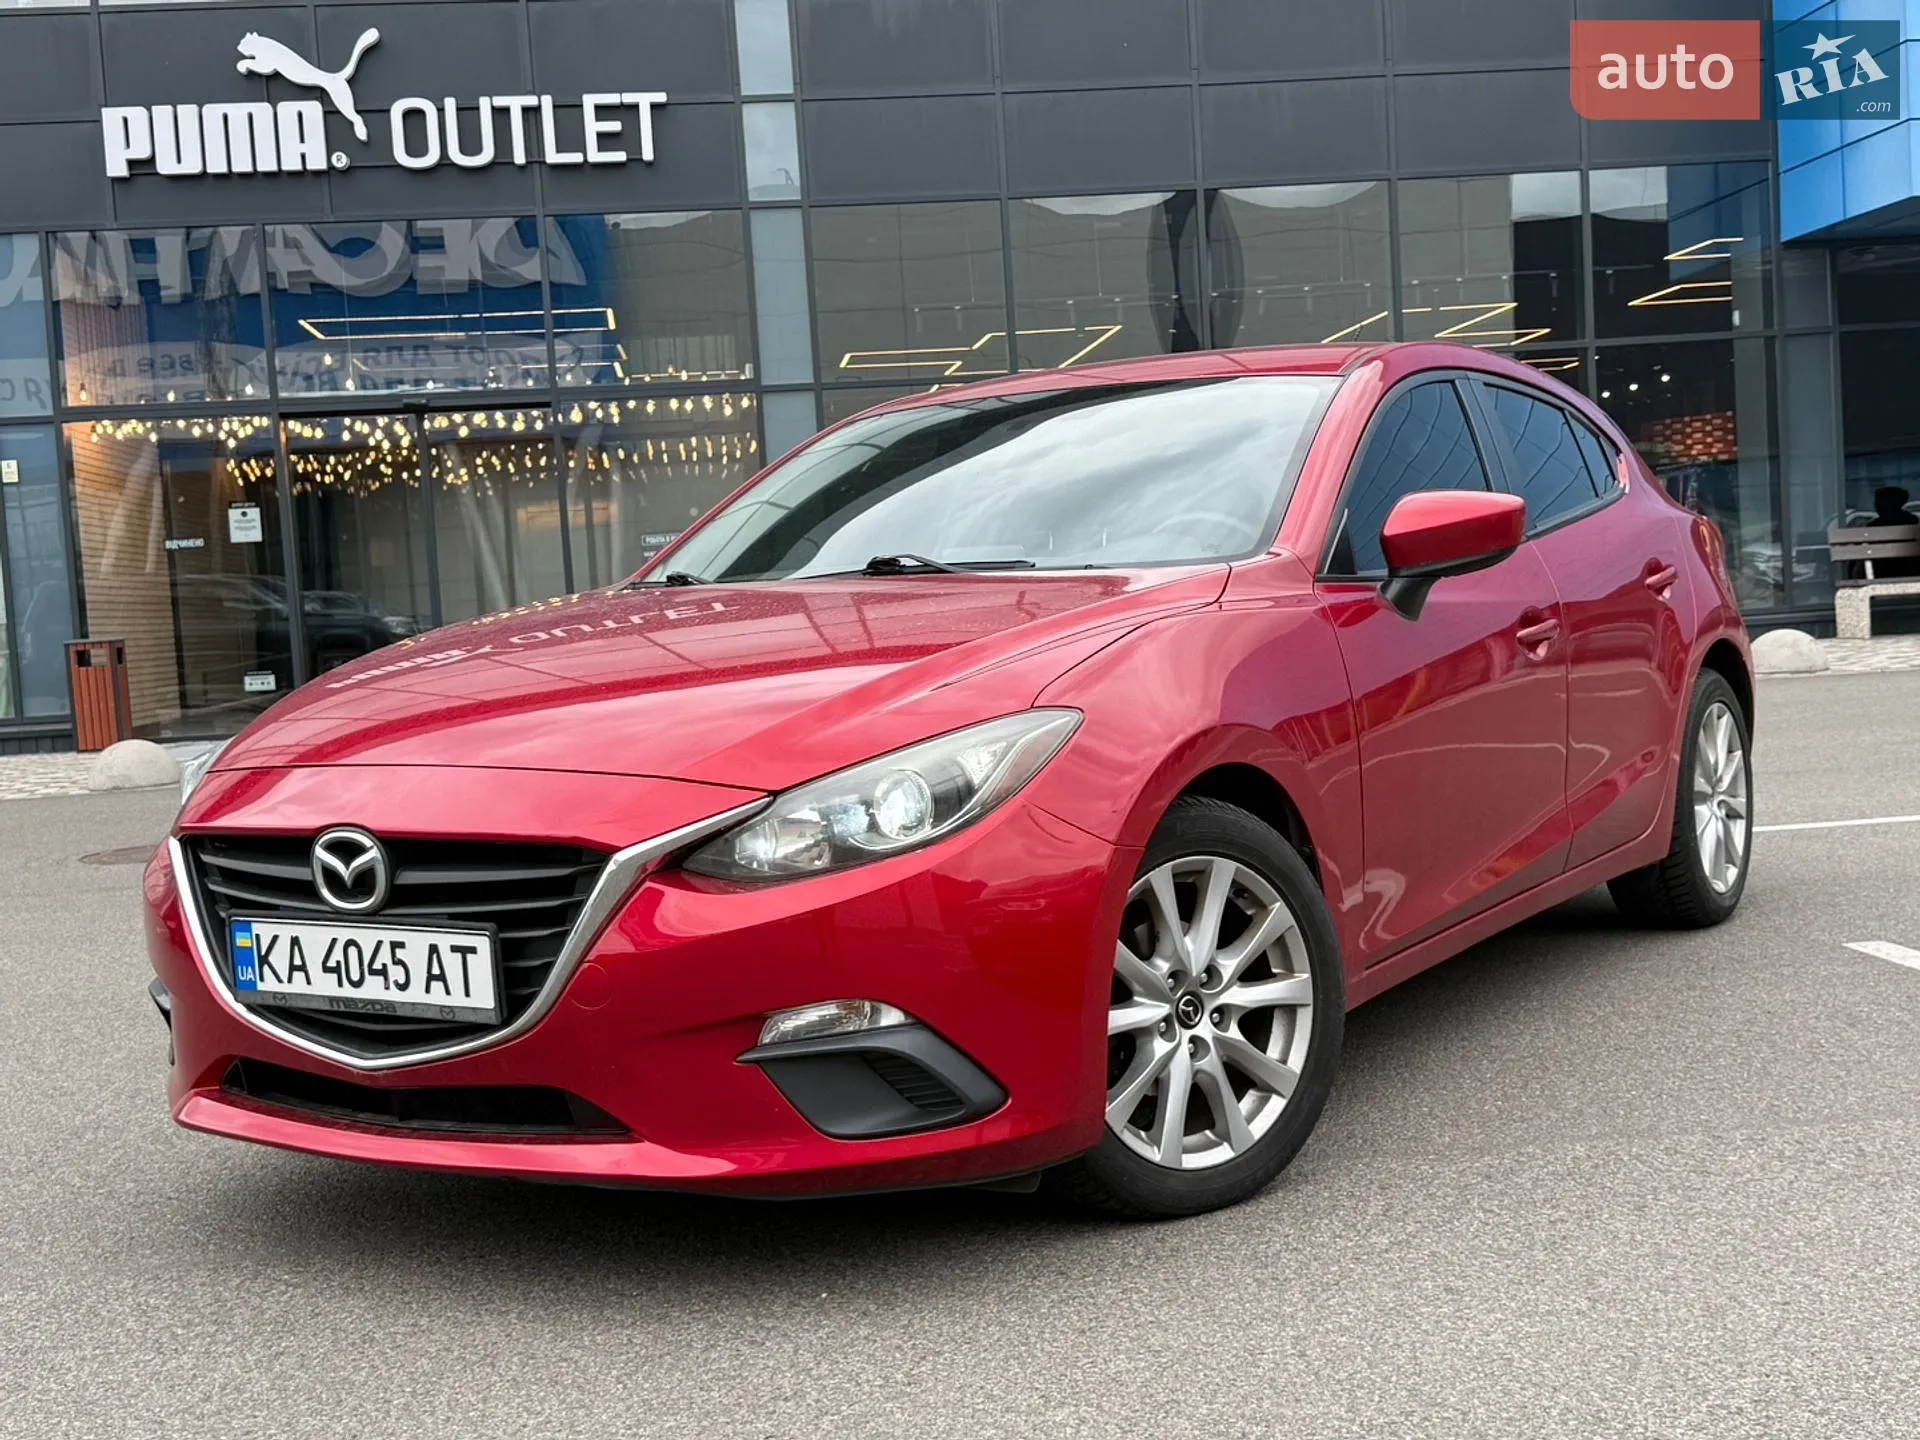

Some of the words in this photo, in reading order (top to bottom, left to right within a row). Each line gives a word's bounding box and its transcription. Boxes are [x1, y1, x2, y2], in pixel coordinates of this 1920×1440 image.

[102, 99, 328, 178] PUMA
[390, 92, 668, 169] OUTLET
[238, 965, 255, 982] UA
[255, 933, 312, 985] KA
[321, 937, 411, 992] 4045
[424, 943, 478, 997] AT
